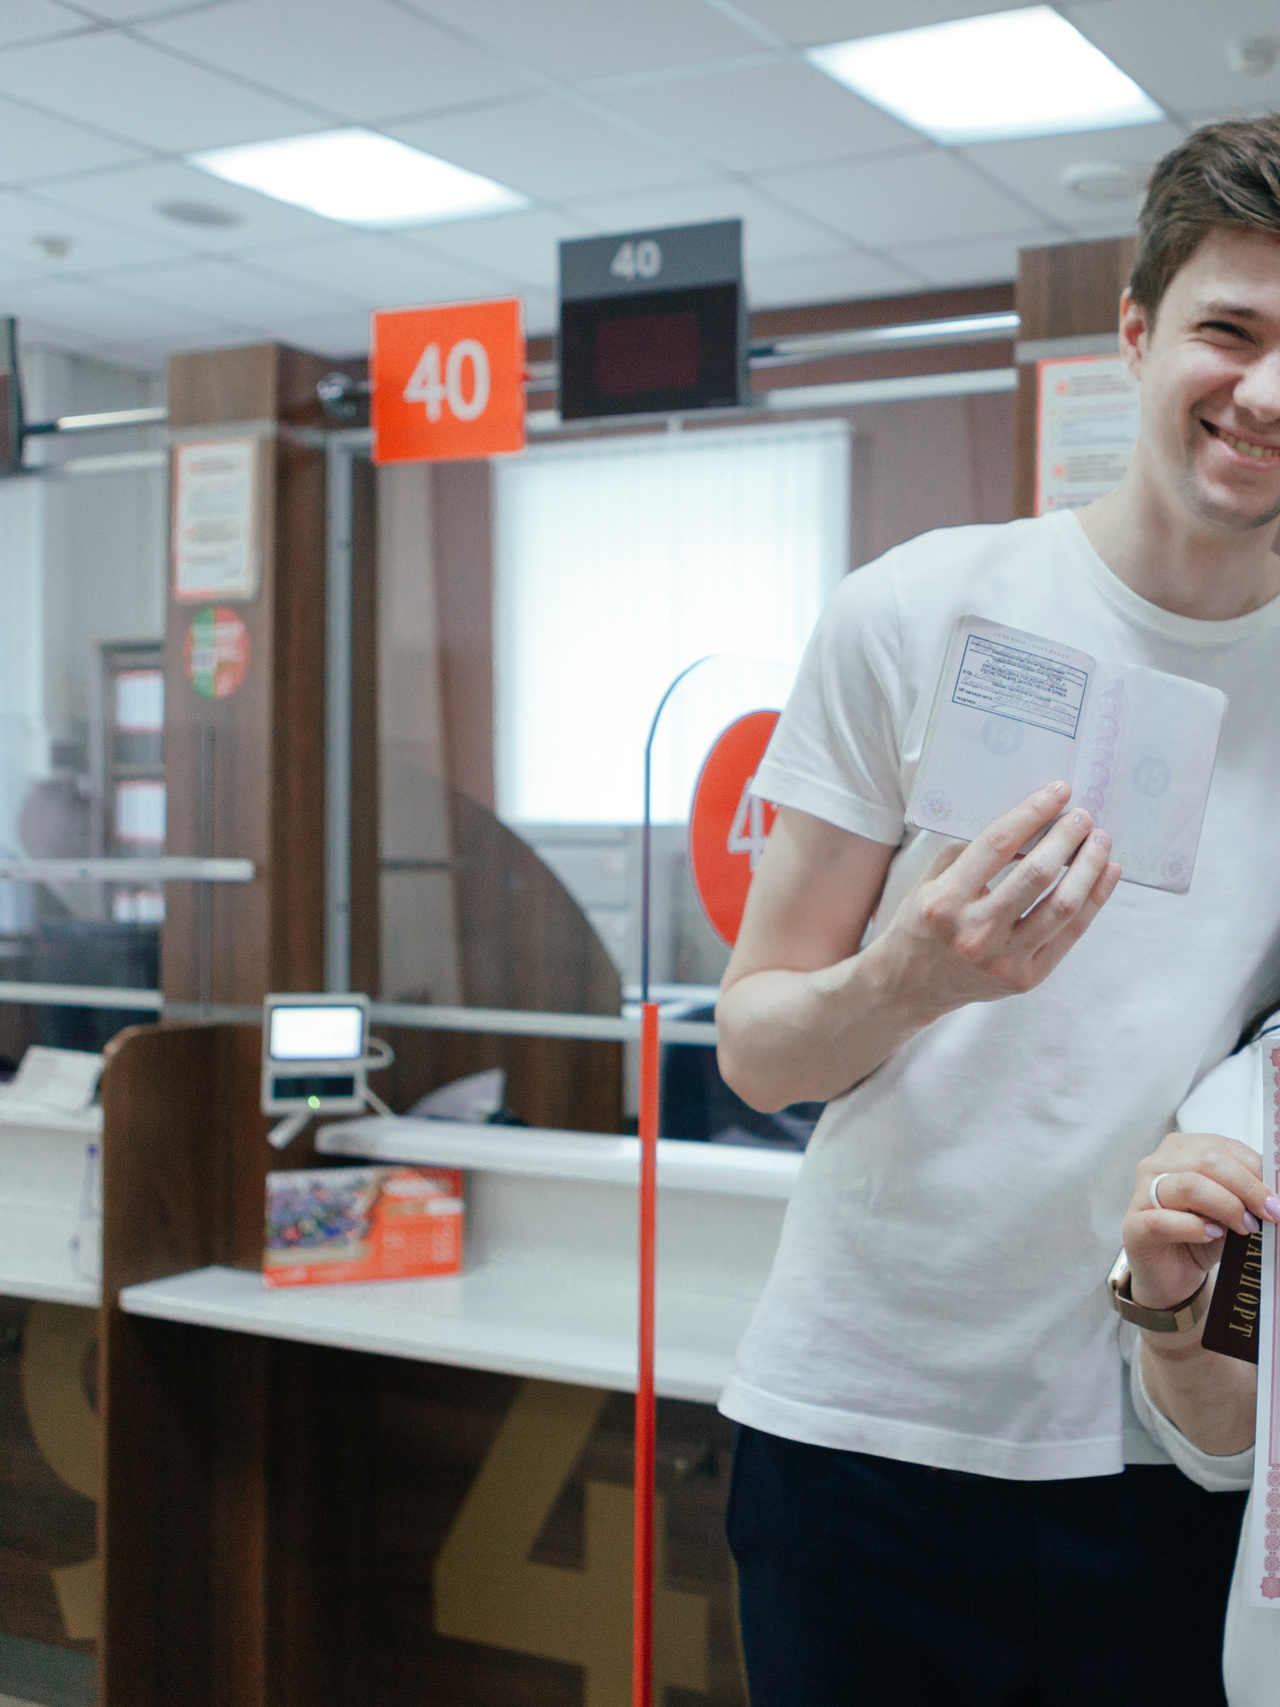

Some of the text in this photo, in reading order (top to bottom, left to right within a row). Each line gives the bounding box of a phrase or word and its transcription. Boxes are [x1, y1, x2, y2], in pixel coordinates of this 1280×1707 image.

[611, 239, 662, 279] 40
[403, 339, 490, 422] 40
[727, 776, 777, 872] 4
